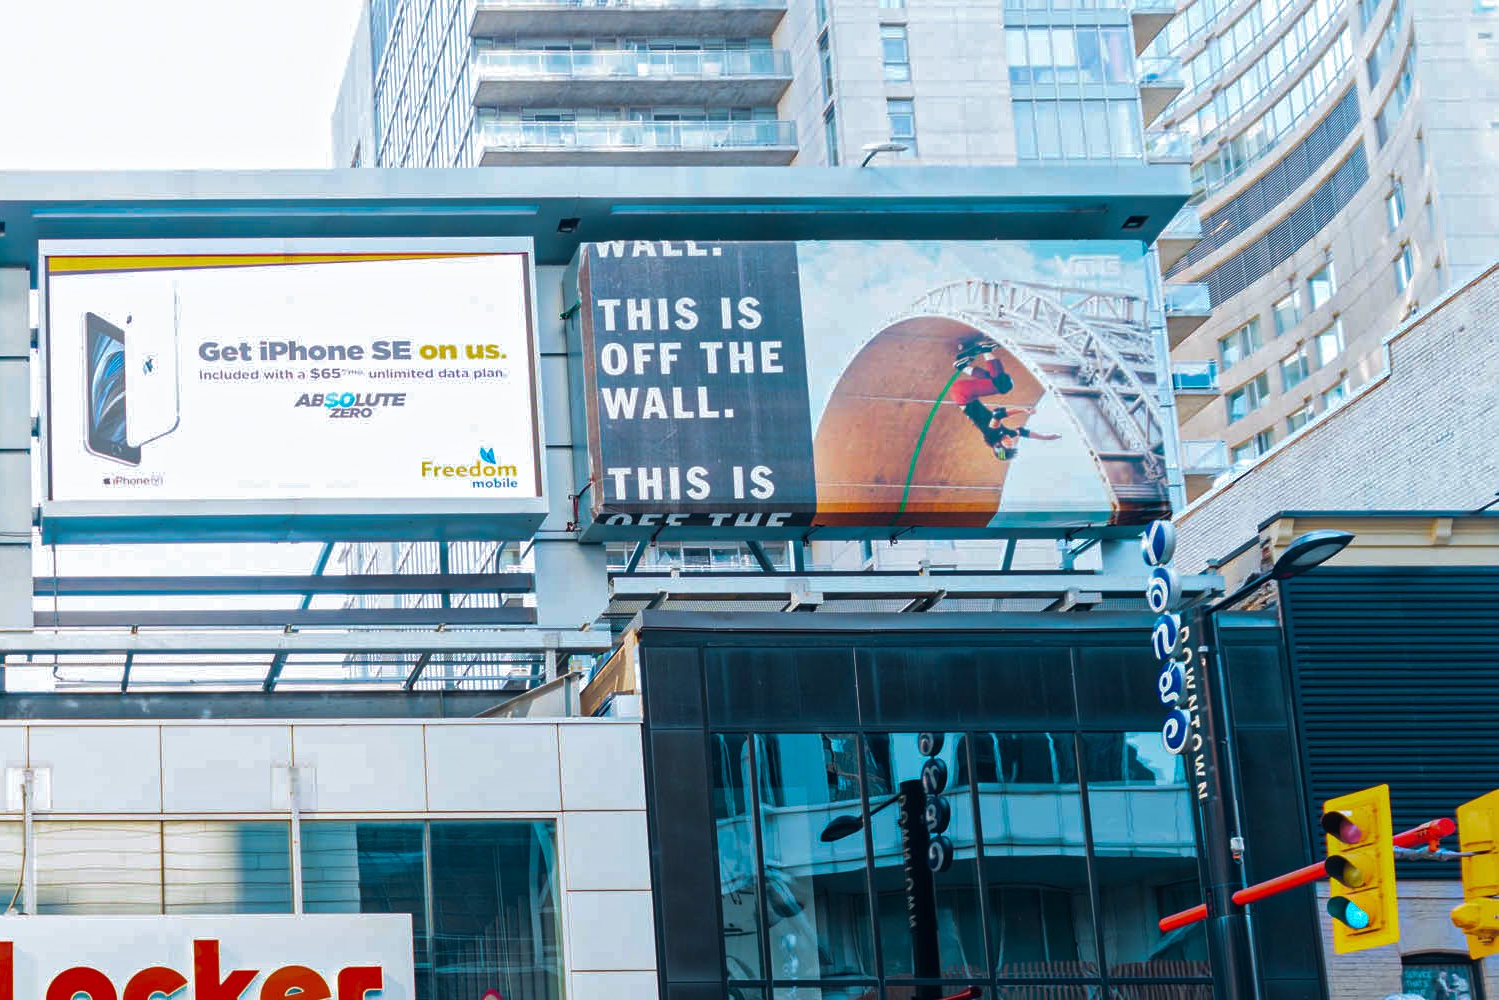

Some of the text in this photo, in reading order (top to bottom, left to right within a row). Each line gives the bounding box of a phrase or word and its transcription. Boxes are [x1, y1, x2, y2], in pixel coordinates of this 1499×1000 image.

[598, 297, 762, 331] THIS IS
[199, 341, 507, 361] Get iPhone SE on us.
[601, 340, 784, 376] OFF THE
[199, 369, 259, 380] Included
[264, 369, 294, 380] with
[297, 371, 306, 379] a
[369, 368, 434, 379] unlimited
[438, 368, 470, 379] data
[329, 408, 373, 418] ZERO
[601, 386, 735, 419] WALL.
[422, 460, 517, 477] Freedom
[472, 478, 518, 489] mobile
[607, 465, 775, 500] THIS IS
[1180, 626, 1208, 799] DOWNTOWN
